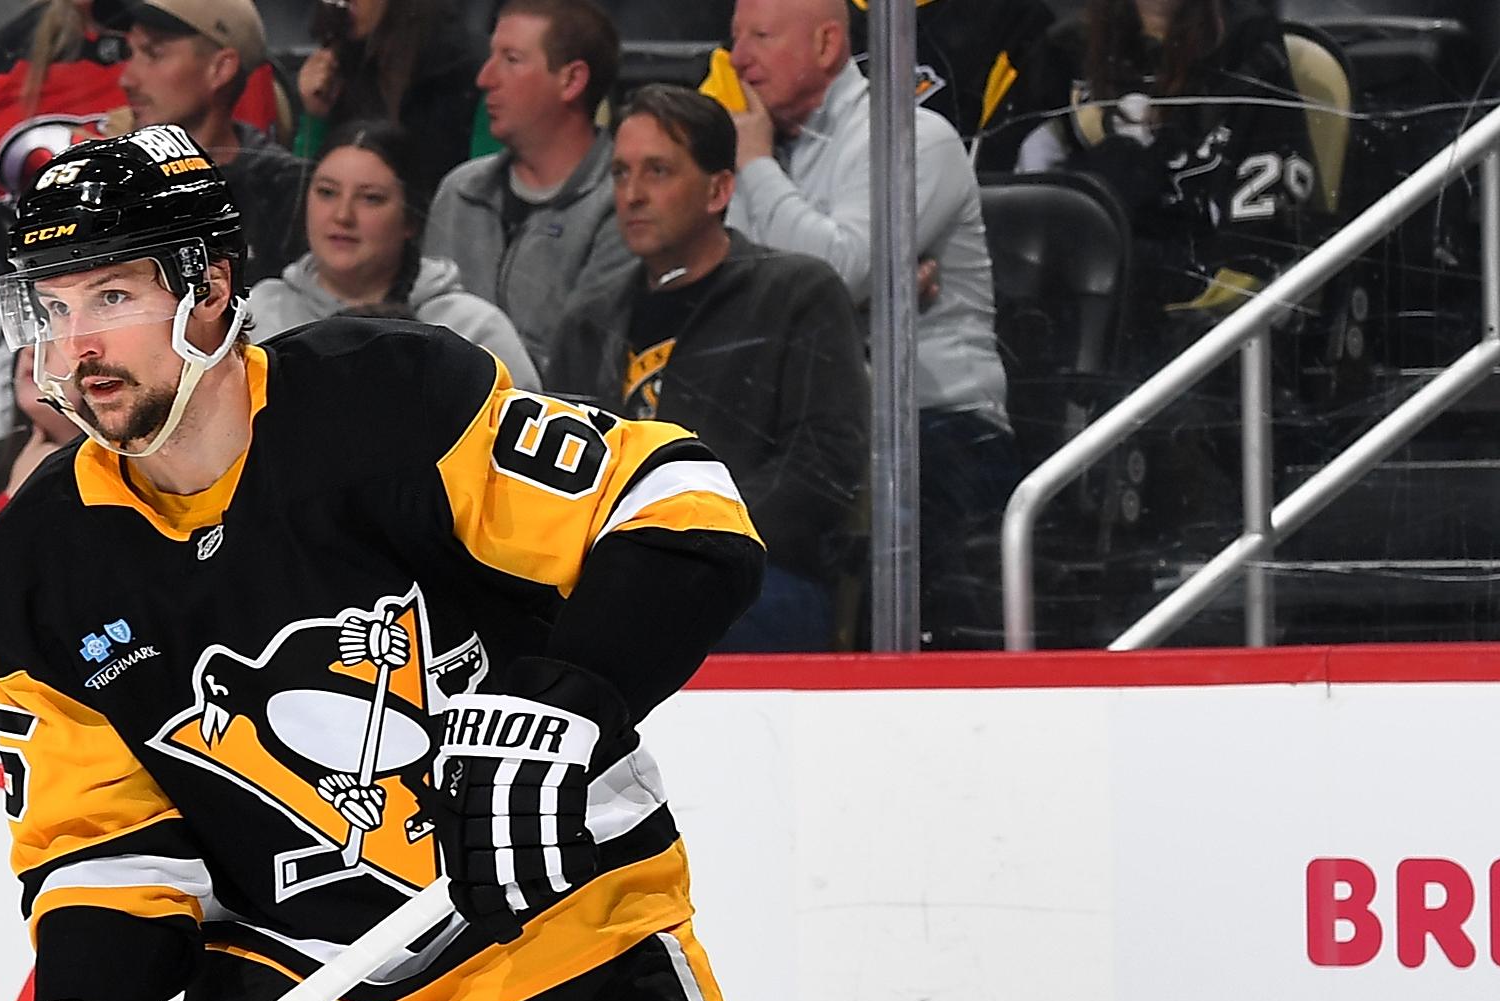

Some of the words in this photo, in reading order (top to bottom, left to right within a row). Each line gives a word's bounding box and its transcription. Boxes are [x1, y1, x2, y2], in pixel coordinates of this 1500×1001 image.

[34, 158, 91, 191] 65
[23, 222, 77, 245] CCM
[490, 396, 622, 500] 6
[90, 645, 162, 690] HIGHMARK
